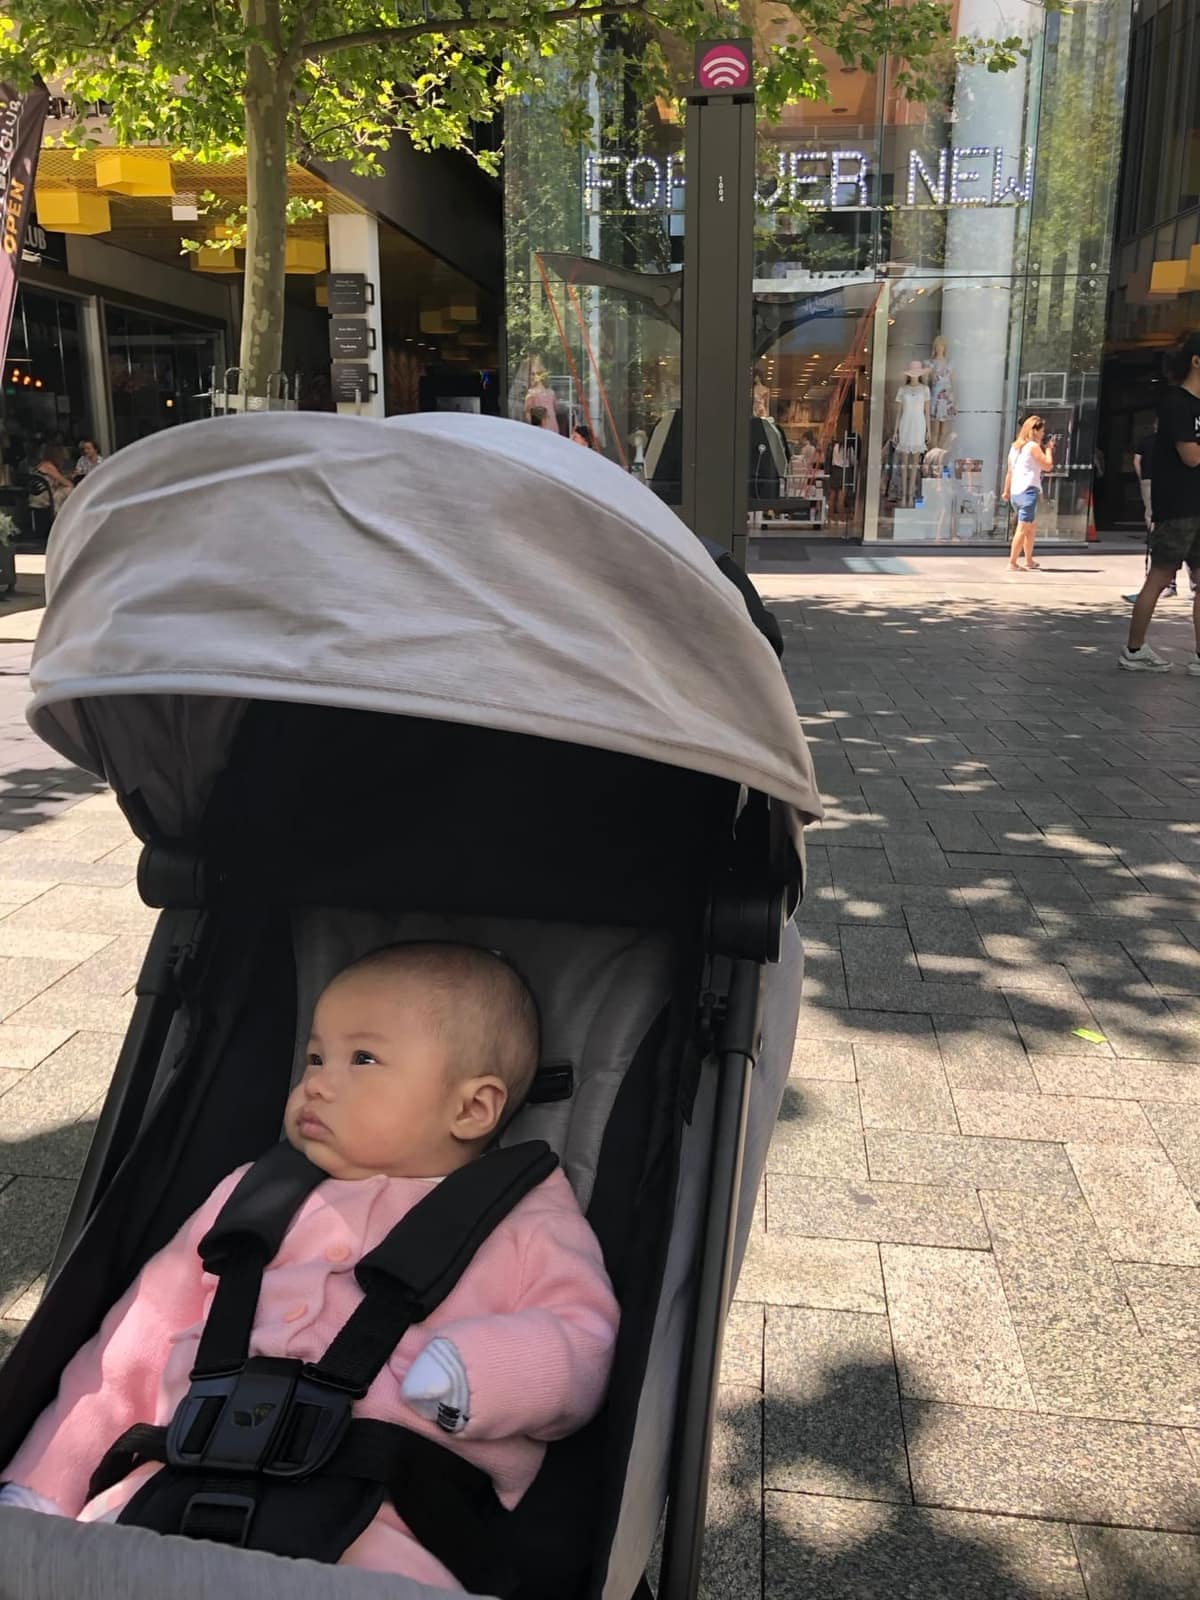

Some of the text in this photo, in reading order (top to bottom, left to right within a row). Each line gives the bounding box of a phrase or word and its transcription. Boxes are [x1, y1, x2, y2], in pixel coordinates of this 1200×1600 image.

[584, 146, 1034, 209] FORVER NEW
[4, 177, 25, 255] OPEN
